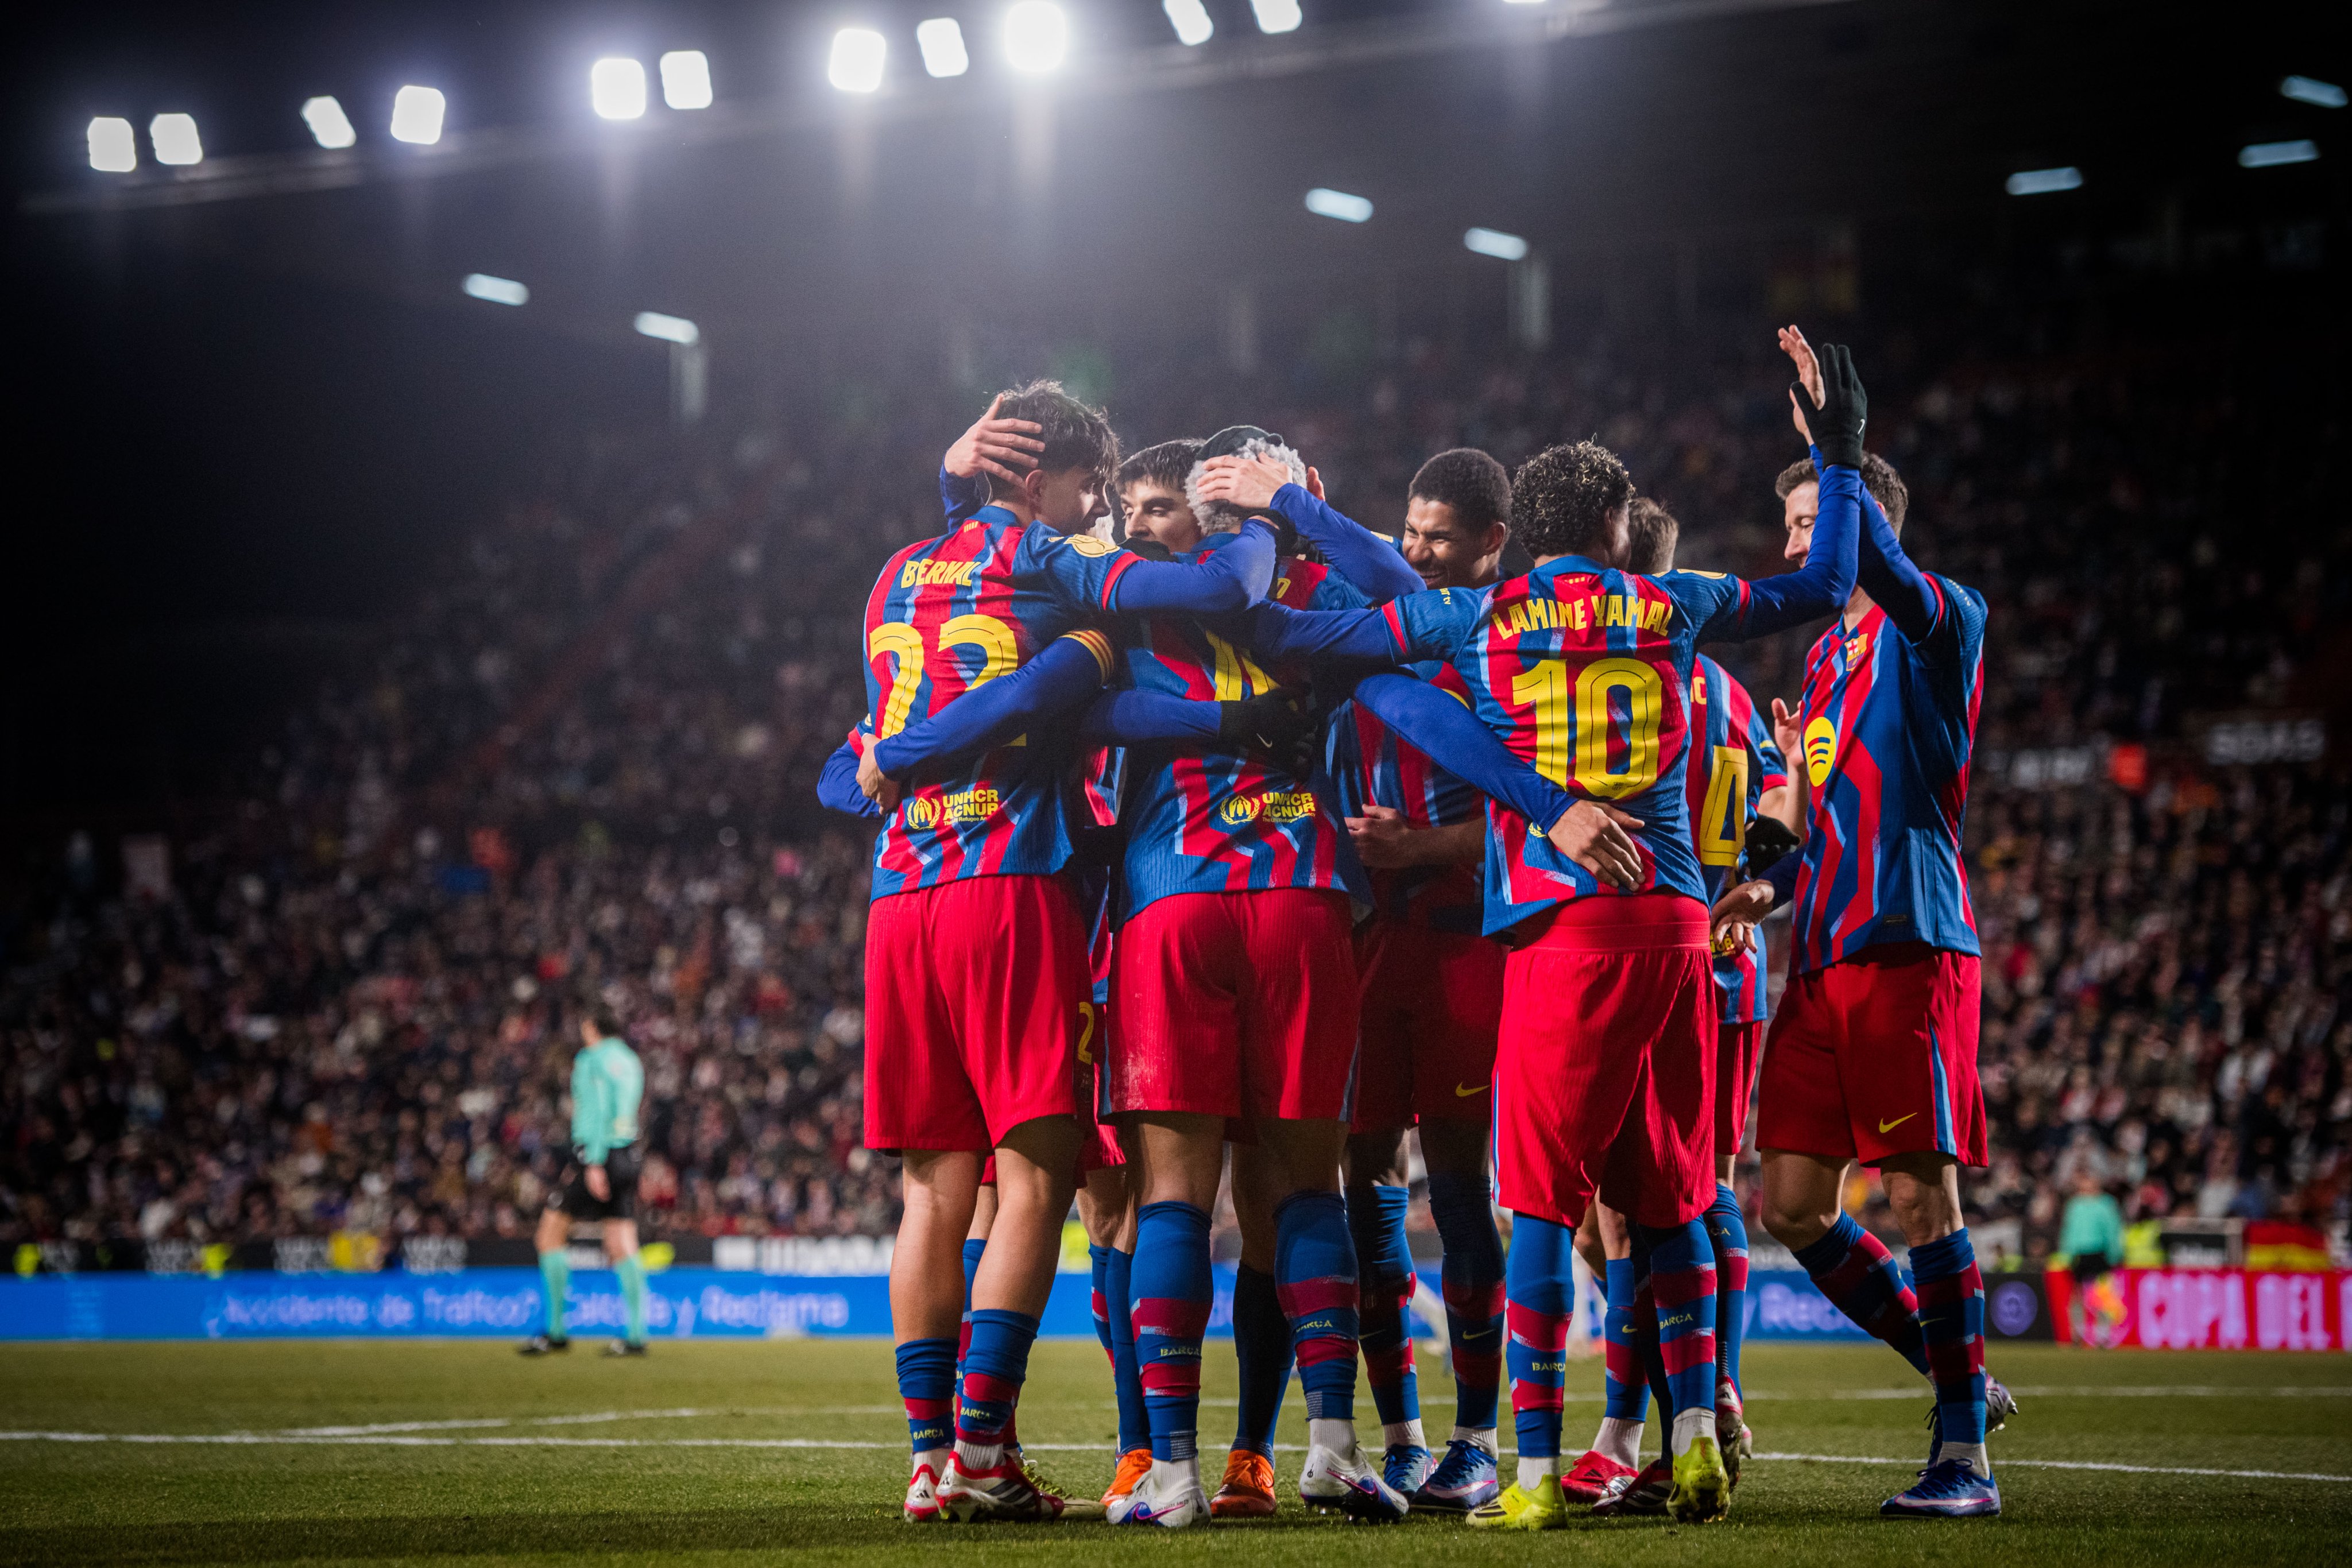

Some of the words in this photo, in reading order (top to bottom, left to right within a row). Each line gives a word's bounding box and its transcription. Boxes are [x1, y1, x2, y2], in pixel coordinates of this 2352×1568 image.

[901, 559, 981, 588] BERNAL
[1491, 598, 1587, 640] LAMINE
[1591, 595, 1673, 637] YAMAL
[1512, 657, 1662, 800] 10
[943, 789, 998, 808] UNHCR
[1262, 792, 1313, 806] UNHCR
[1263, 802, 1316, 817] ACNUR
[1078, 1001, 1094, 1065] 2
[1660, 1314, 1693, 1330] BARÇA
[914, 1428, 944, 1440] BARÇA
